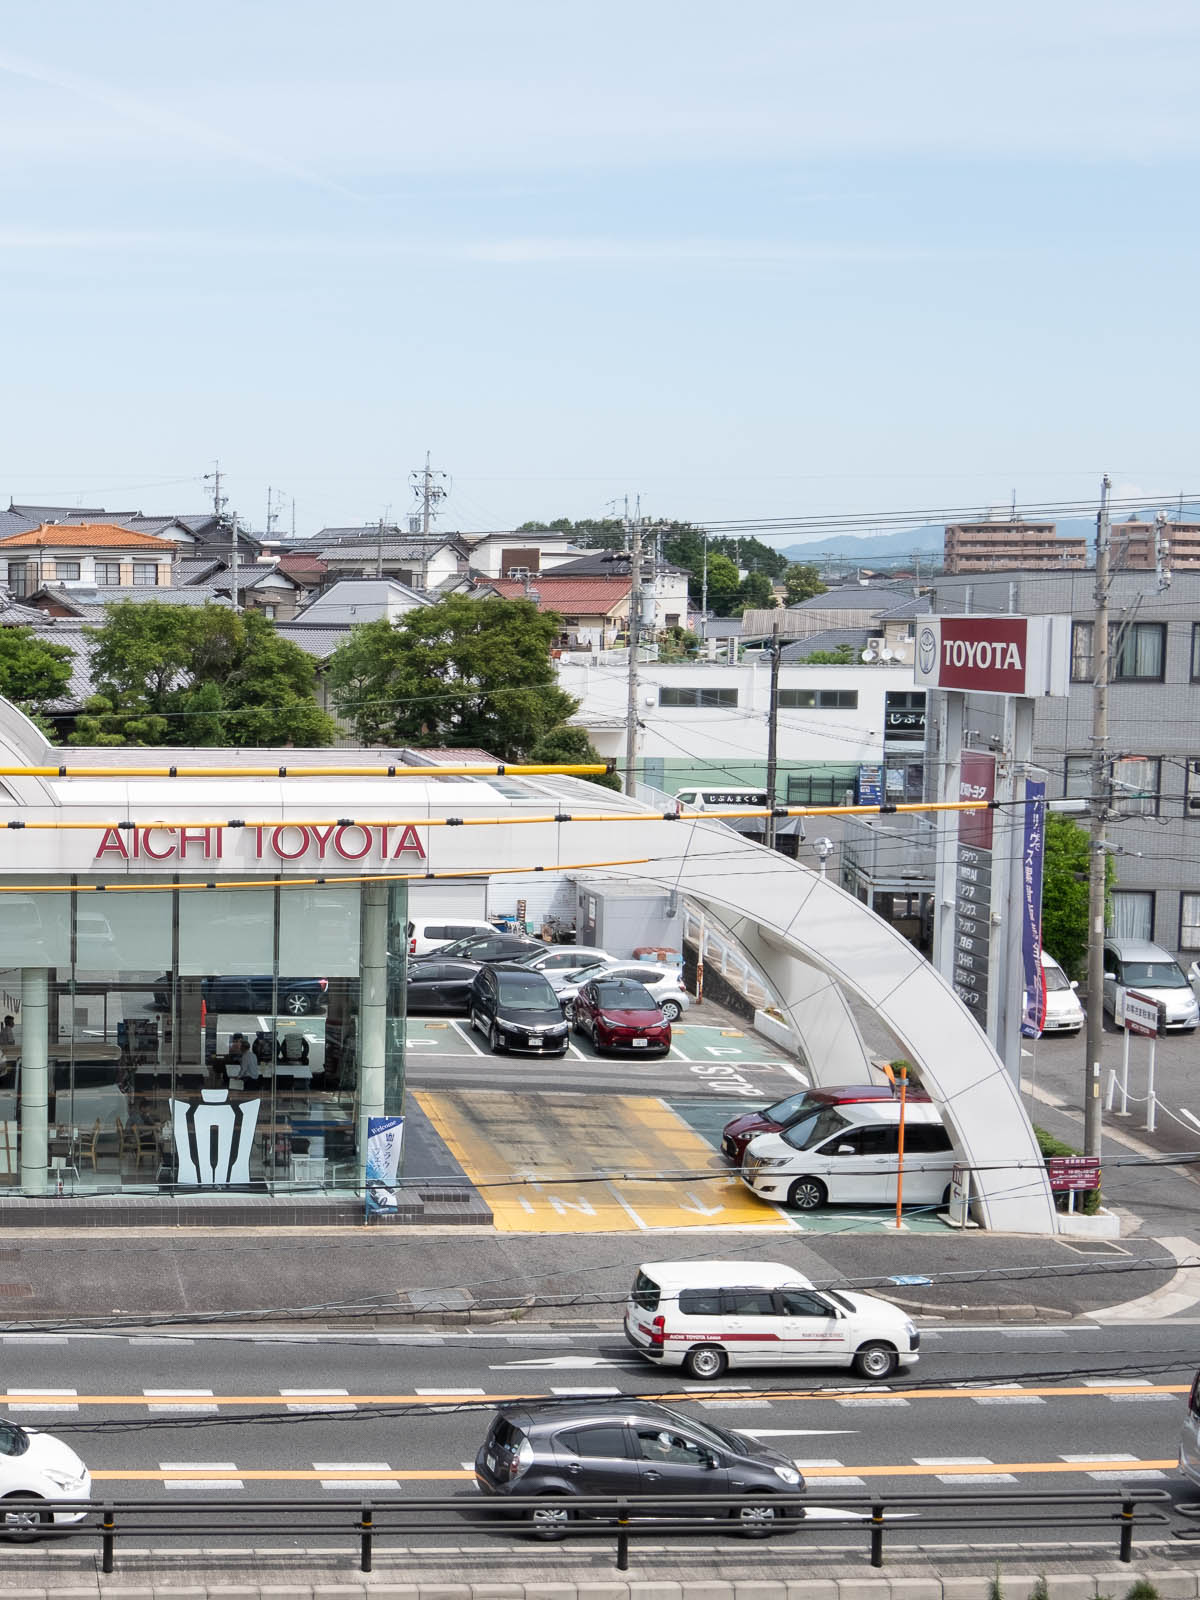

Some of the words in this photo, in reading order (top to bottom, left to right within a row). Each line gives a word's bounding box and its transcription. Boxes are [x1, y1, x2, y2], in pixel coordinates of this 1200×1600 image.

[943, 640, 1023, 670] TOYOTA
[709, 795, 758, 803] じぶんまくら
[95, 821, 224, 860] AICHI
[247, 821, 427, 861] TOYOTA
[960, 936, 974, 950] 86
[689, 1065, 765, 1096] STOP
[371, 1120, 397, 1134] Welcome
[382, 1142, 393, 1178] クラウン
